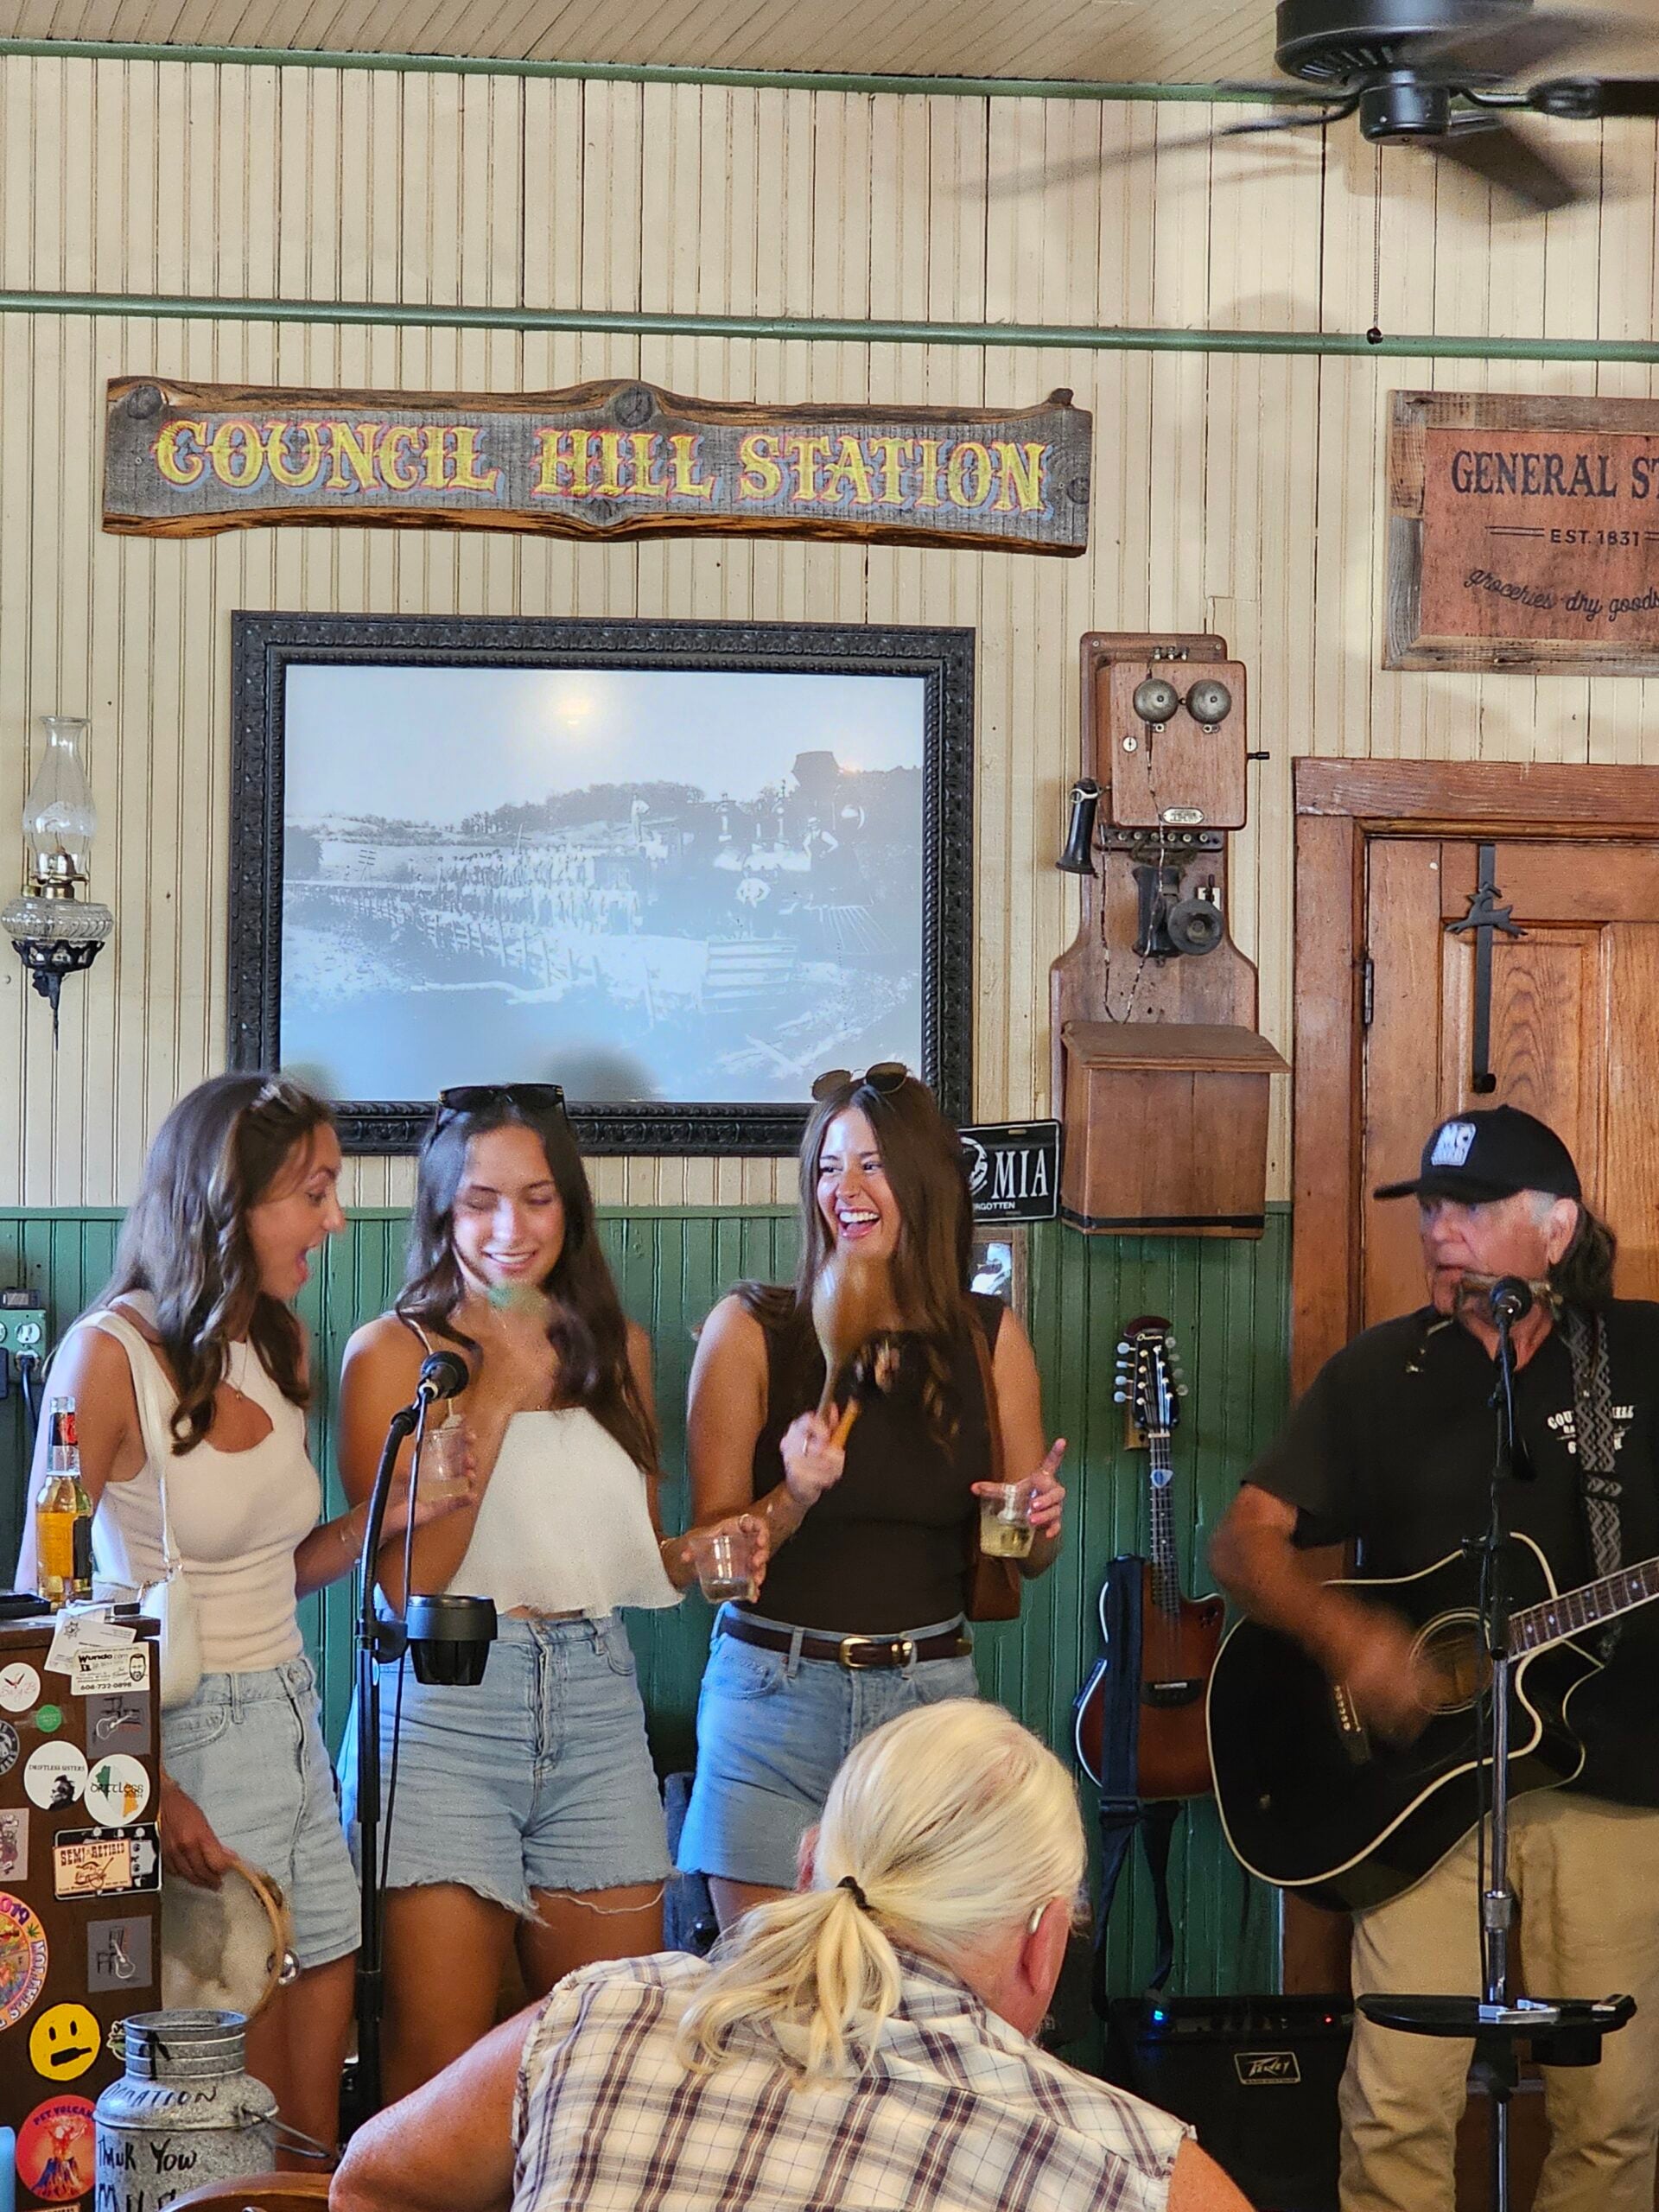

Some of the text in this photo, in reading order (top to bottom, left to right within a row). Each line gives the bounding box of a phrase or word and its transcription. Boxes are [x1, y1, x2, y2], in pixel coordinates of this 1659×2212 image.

[149, 418, 1052, 518] COUNCIL HILL STATION
[1451, 449, 1618, 498] GENERAL
[1550, 529, 1640, 547] EST. 1831
[1463, 569, 1555, 610] groceries
[1565, 589, 1603, 622] dry
[990, 1147, 1049, 1199] MIA
[973, 1201, 1015, 1211] RGOTTEN
